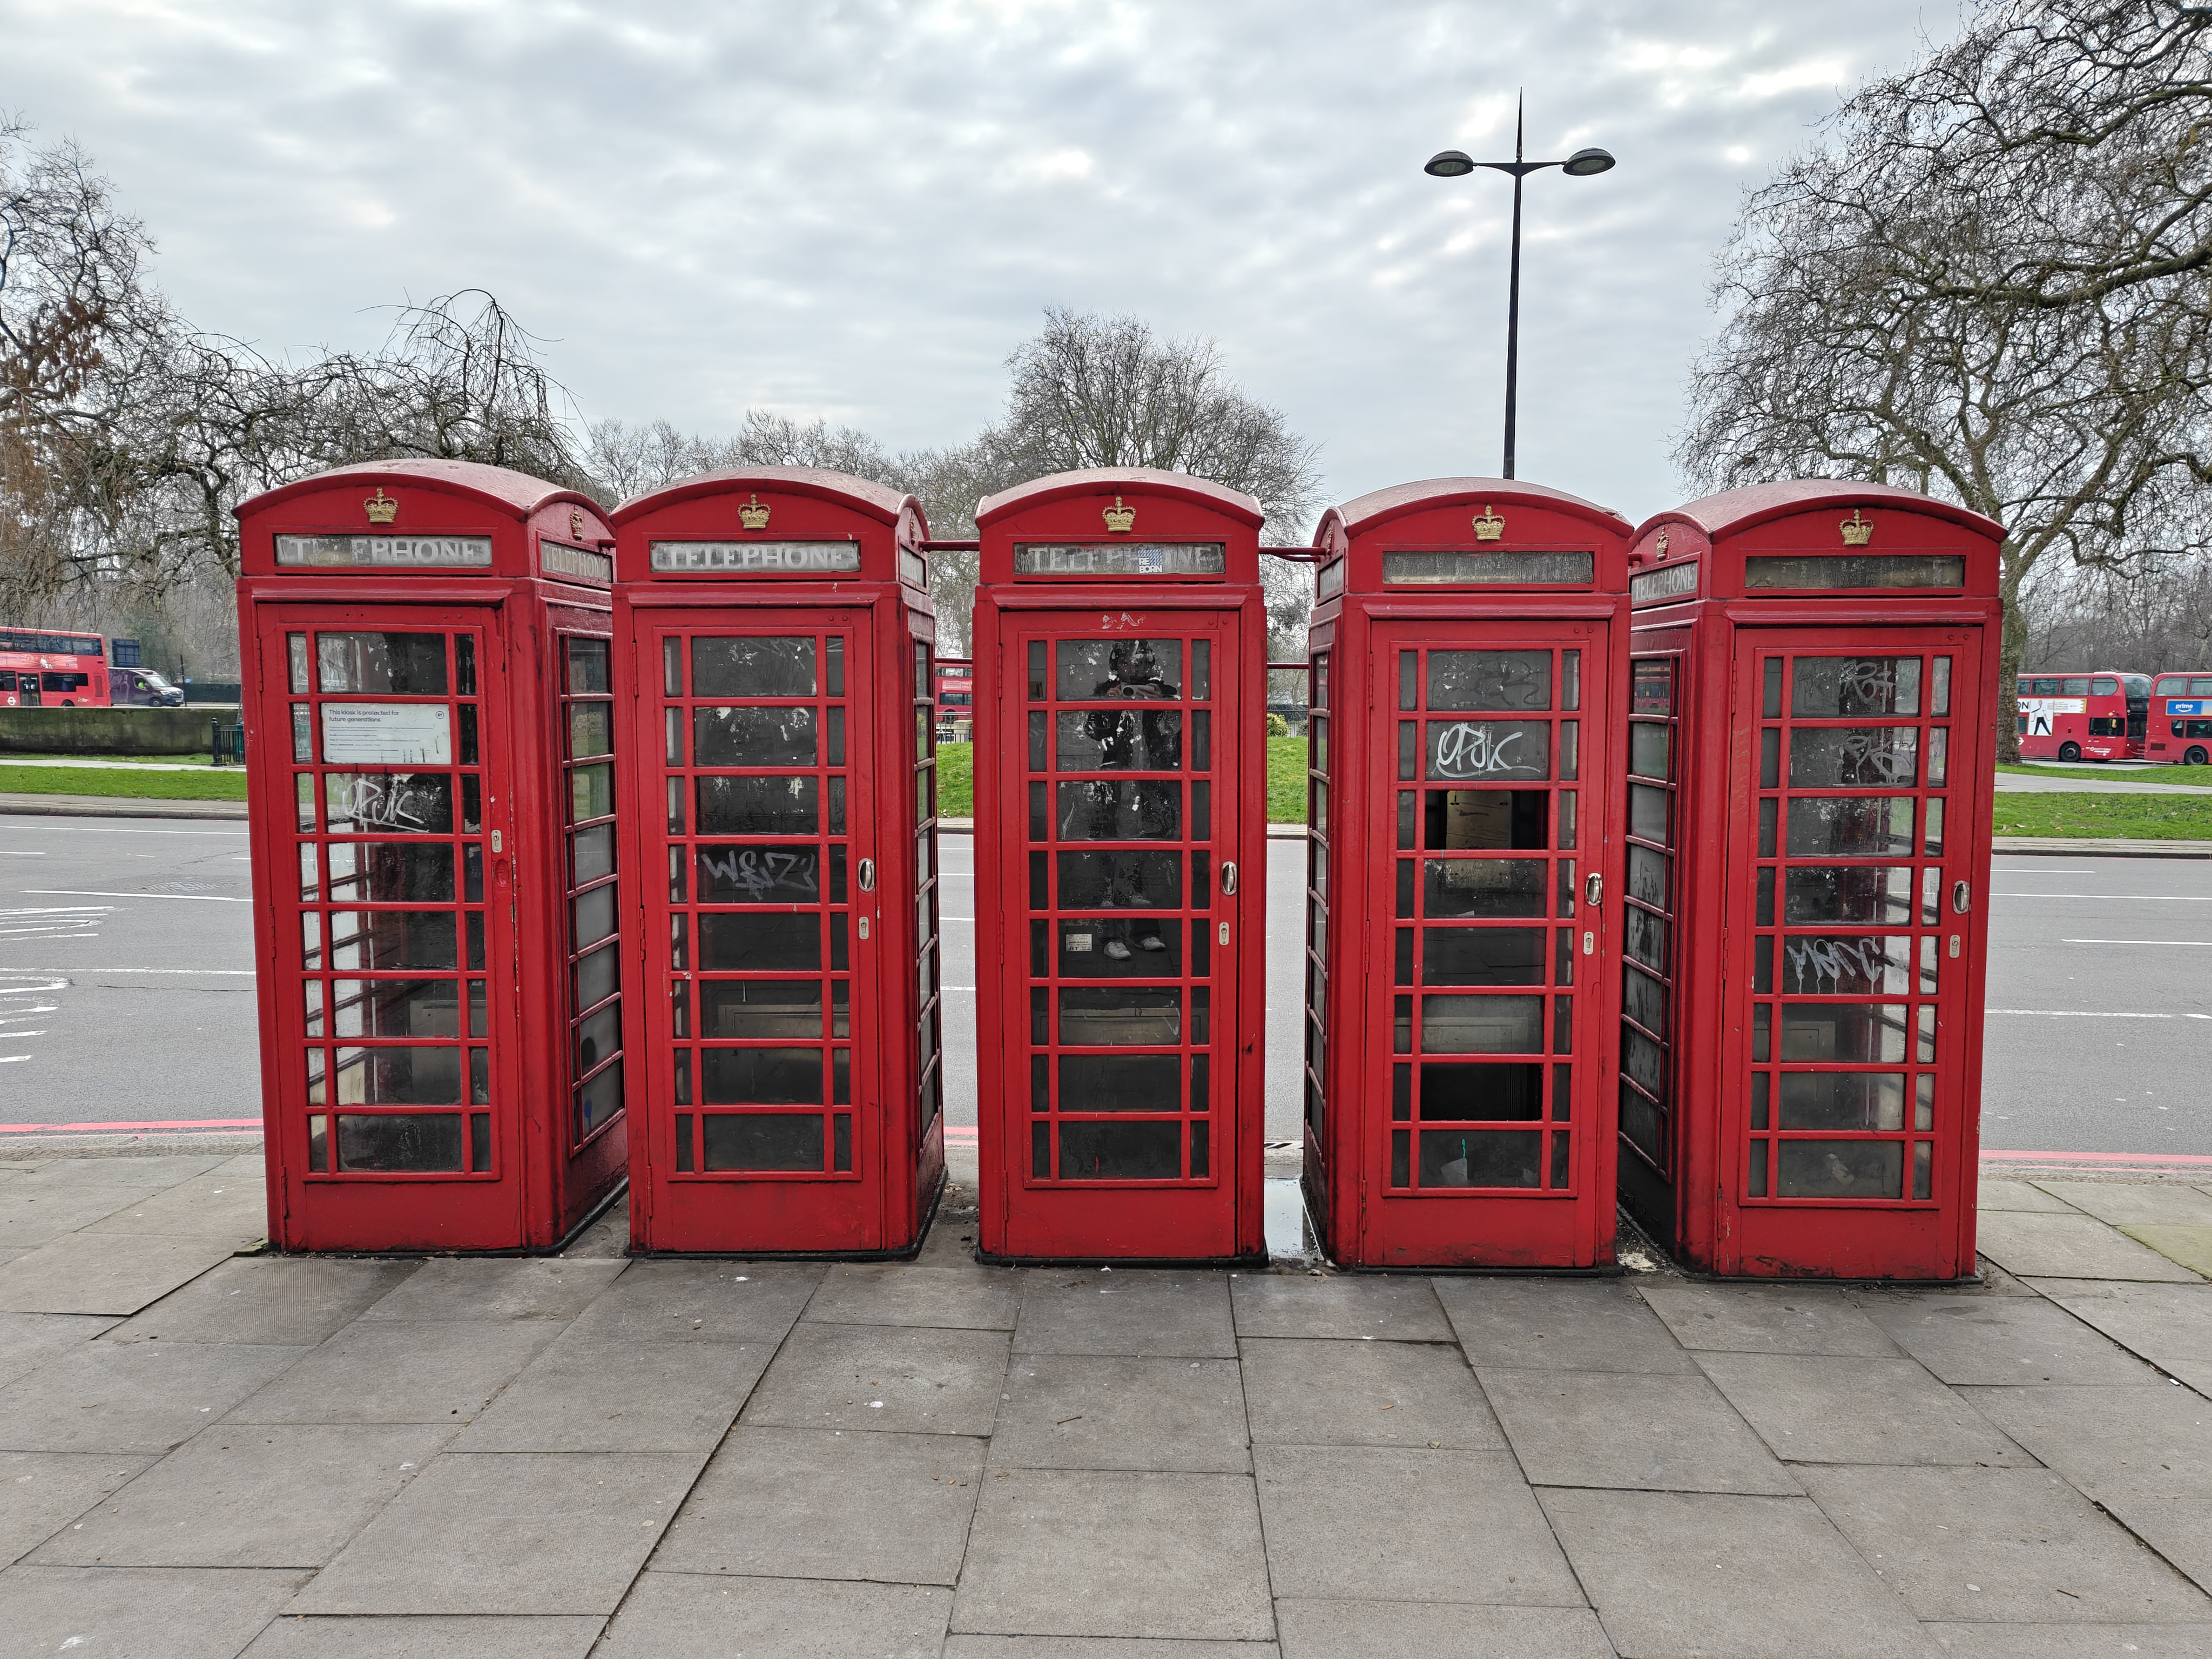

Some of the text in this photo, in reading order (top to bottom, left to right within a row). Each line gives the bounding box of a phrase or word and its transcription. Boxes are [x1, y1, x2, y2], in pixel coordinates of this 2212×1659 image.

[1139, 557, 1150, 565] RE
[1139, 565, 1163, 574] BORN
[1634, 565, 1695, 601] TELEPHONE
